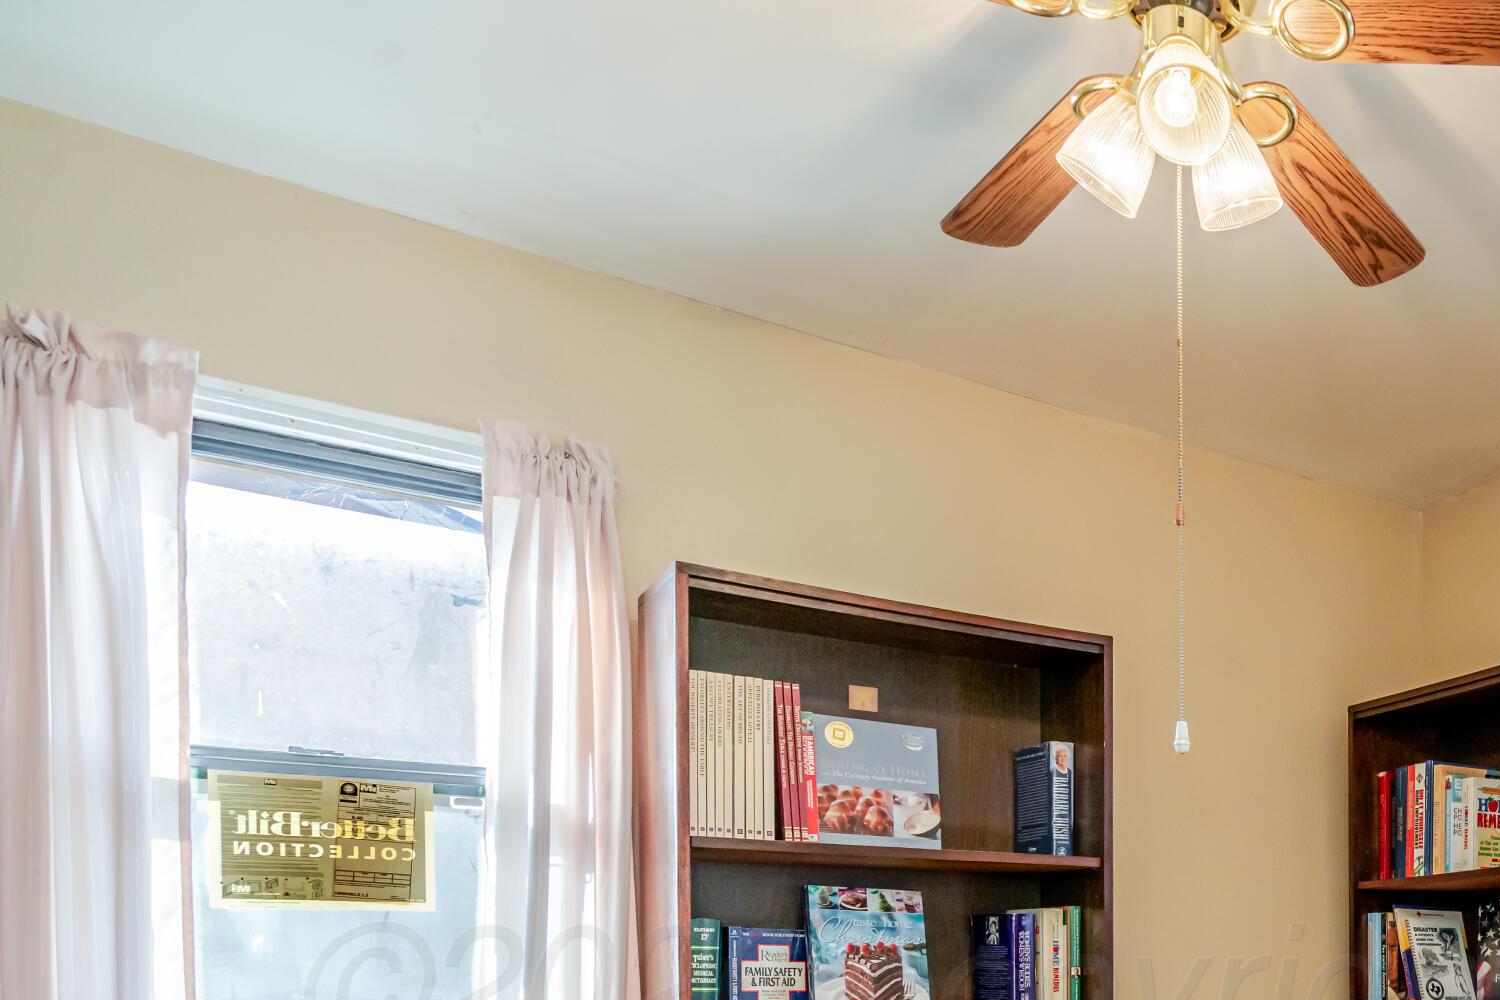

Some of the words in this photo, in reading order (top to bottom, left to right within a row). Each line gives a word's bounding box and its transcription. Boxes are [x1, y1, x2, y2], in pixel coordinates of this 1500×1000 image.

[806, 740, 816, 776] AMERICAN
[1053, 776, 1070, 815] BARBARA
[1053, 817, 1070, 840] BUSH
[818, 916, 925, 945] Christmas
[853, 918, 878, 928] taste
[884, 919, 912, 929] home
[692, 952, 715, 964] Taber's
[744, 967, 774, 977] FAMILY
[774, 967, 804, 977] SAFETY
[751, 977, 758, 987] &
[758, 977, 781, 987] FIRST
[781, 977, 796, 987] AID
